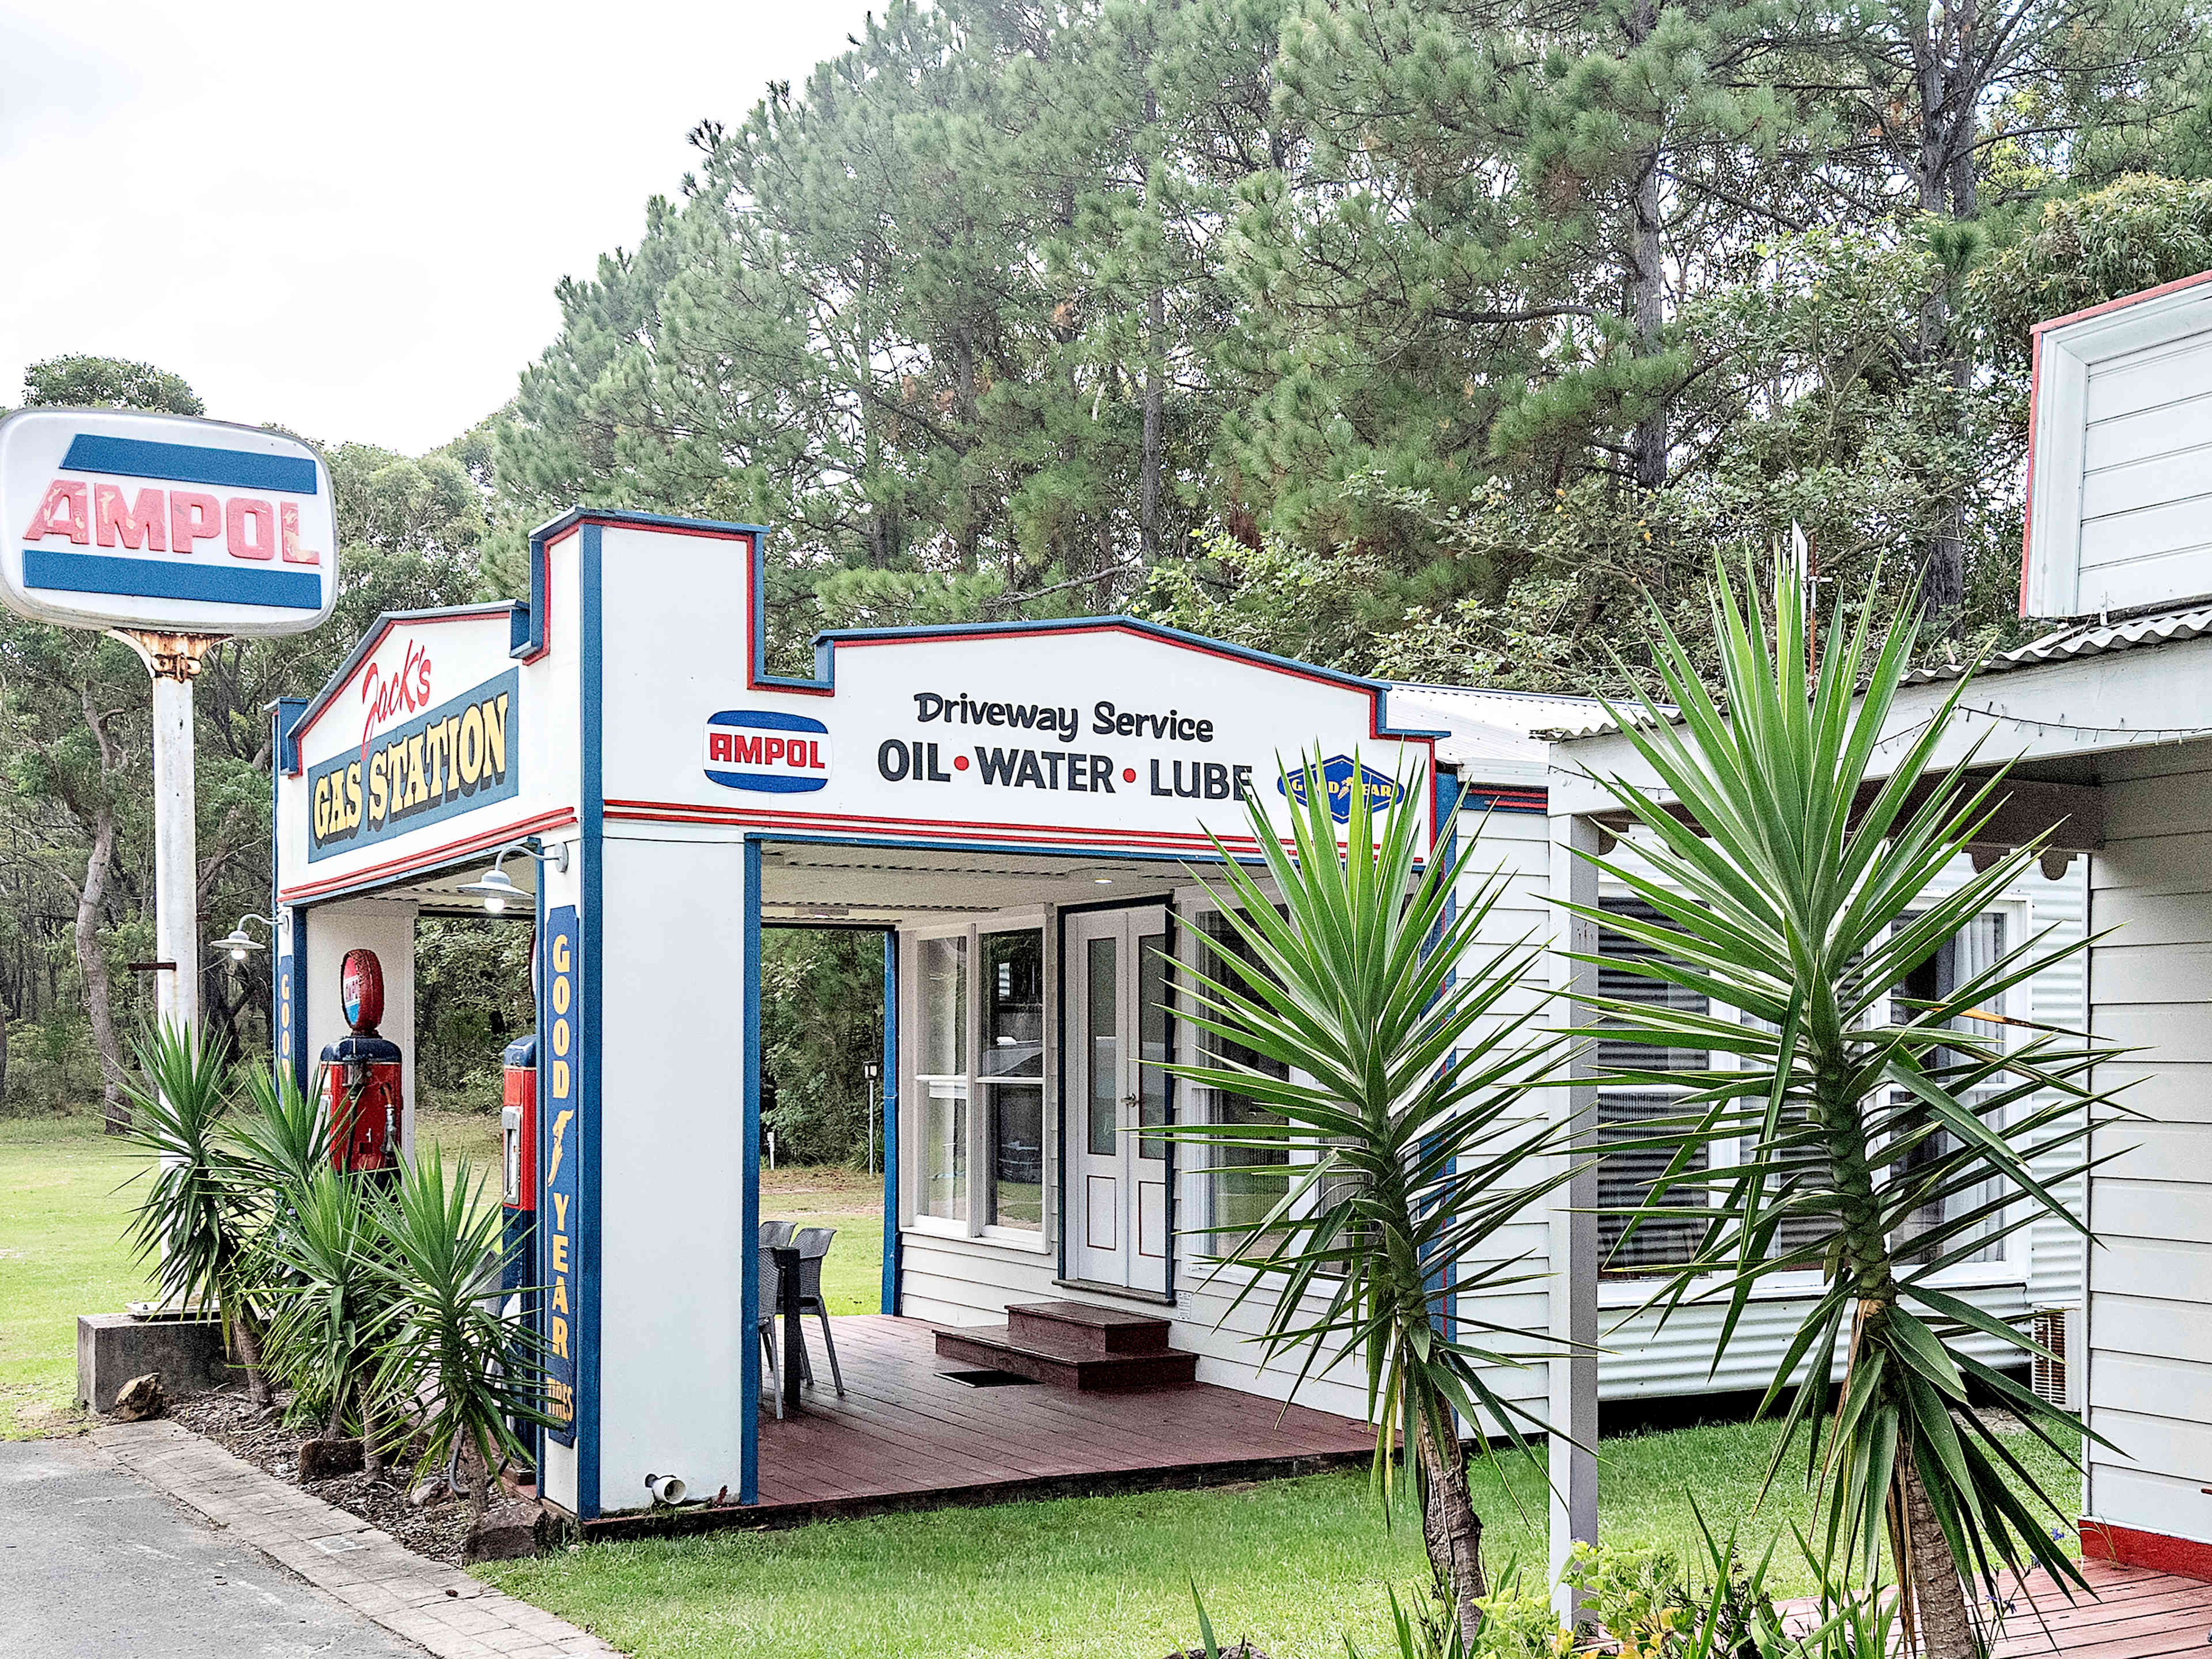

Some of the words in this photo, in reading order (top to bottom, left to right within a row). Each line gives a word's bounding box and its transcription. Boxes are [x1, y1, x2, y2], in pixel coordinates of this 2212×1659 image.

[22, 479, 320, 565] AMPOL
[361, 639, 431, 761] Jack's
[914, 692, 1078, 743] Driveway
[1092, 701, 1213, 743] Service
[313, 760, 362, 843] GAS
[369, 692, 509, 825] STATION
[709, 732, 825, 769] AMPOL
[878, 738, 952, 782] OIL
[974, 746, 1116, 794] WATER
[1150, 759, 1253, 801] LUBE
[1291, 778, 1340, 794] GD
[1359, 783, 1392, 797] EAR
[554, 935, 569, 1100] GOOD
[552, 1194, 569, 1360] YEAR
